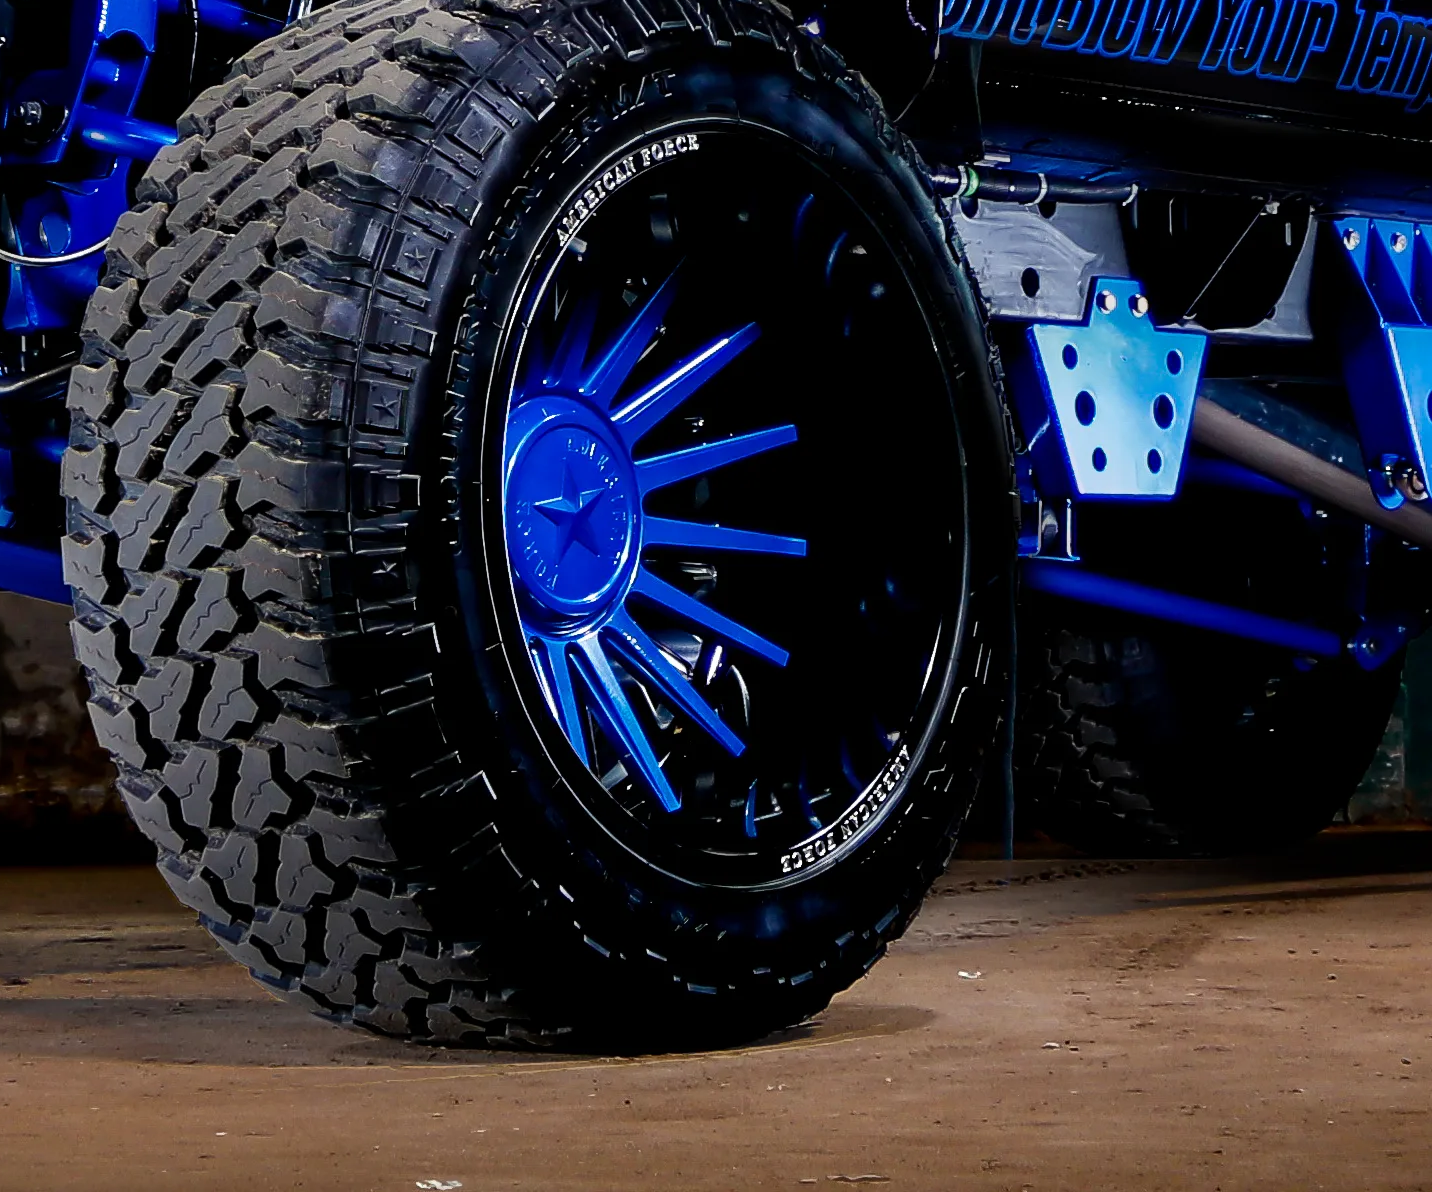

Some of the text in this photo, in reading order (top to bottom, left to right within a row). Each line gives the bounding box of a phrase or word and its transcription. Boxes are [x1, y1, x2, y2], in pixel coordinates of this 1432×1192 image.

[556, 133, 701, 247] AMERICAN FORCE
[780, 743, 911, 874] AMERICAN FORCE
